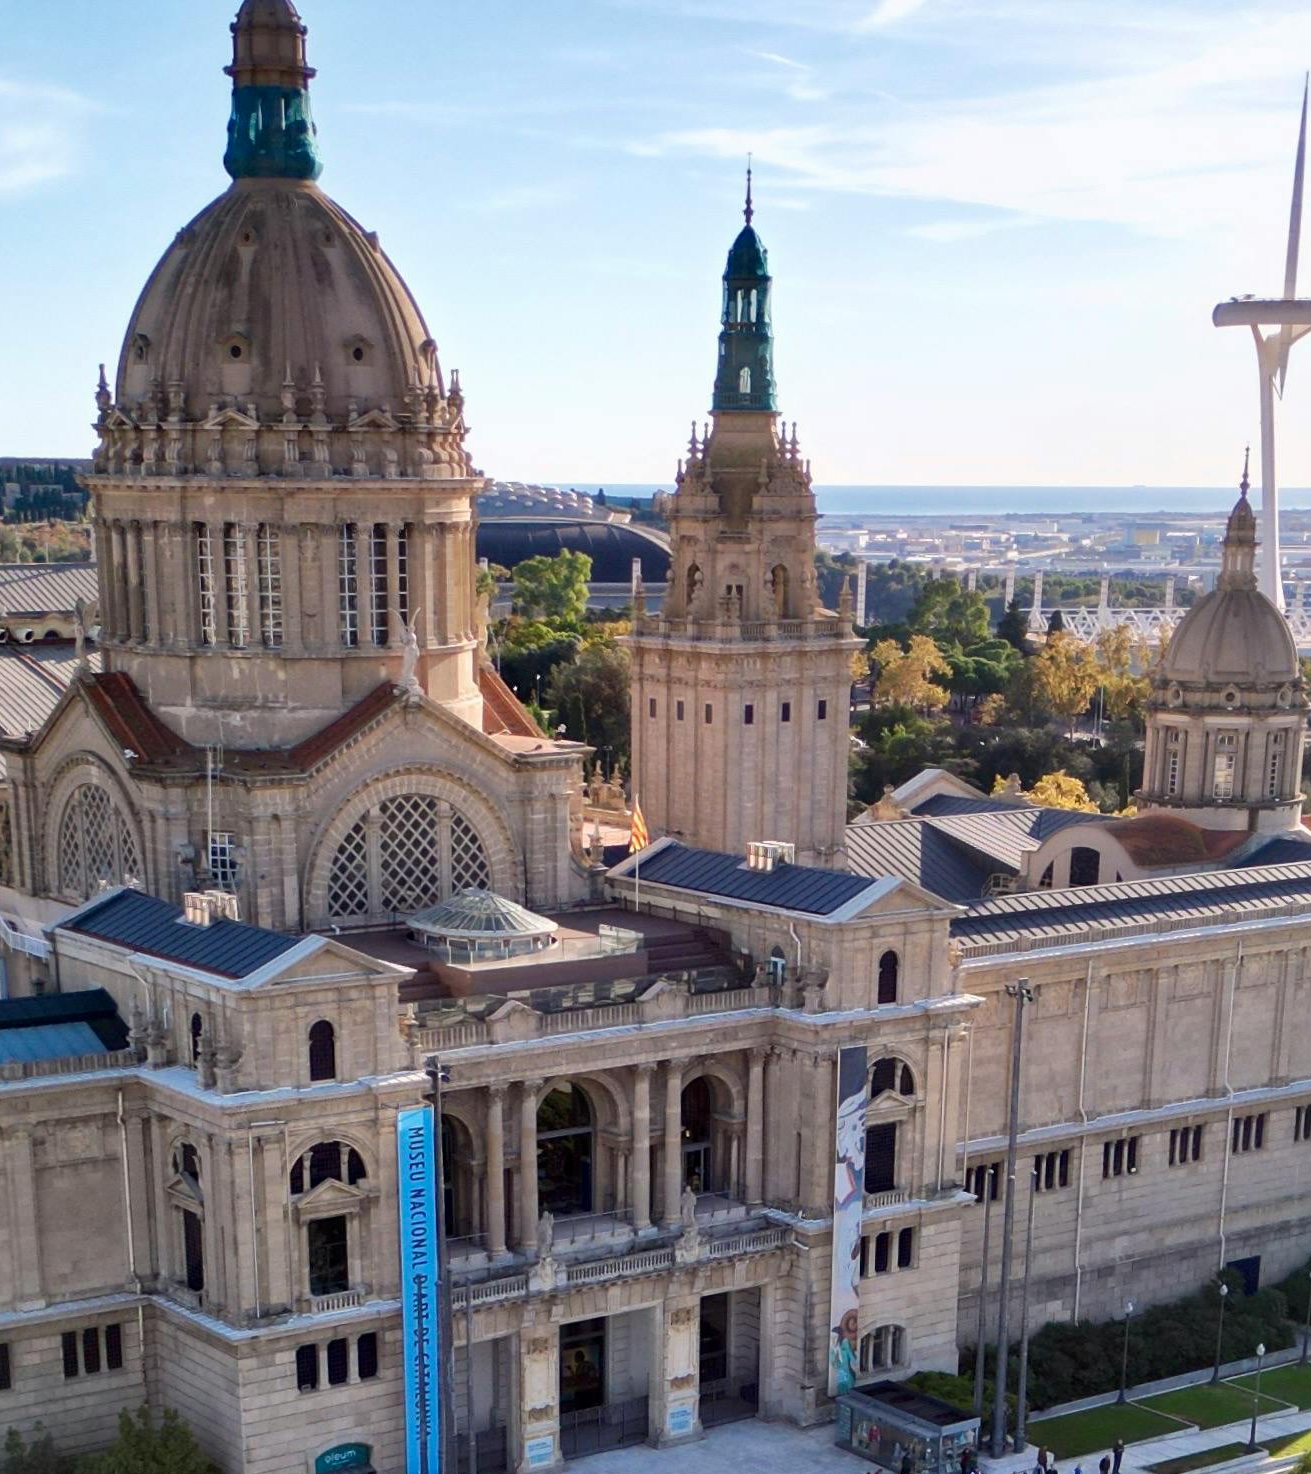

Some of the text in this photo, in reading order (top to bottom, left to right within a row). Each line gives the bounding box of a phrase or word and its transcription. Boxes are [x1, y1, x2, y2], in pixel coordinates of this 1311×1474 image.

[408, 1126, 425, 1181] MUSEU
[409, 1188, 428, 1270] NACIONAL
[412, 1273, 429, 1320] D'ART
[413, 1327, 430, 1348] DE
